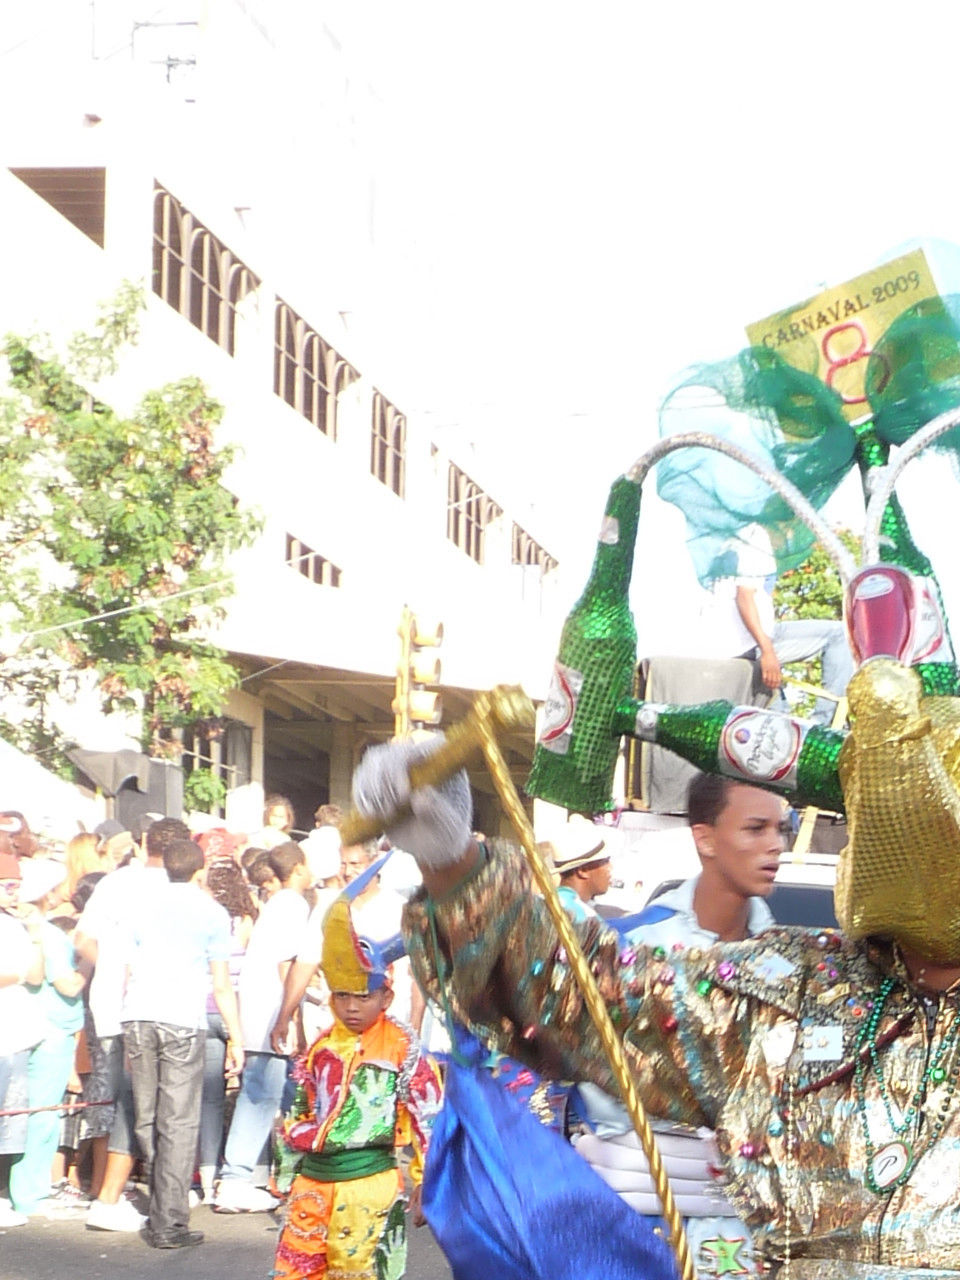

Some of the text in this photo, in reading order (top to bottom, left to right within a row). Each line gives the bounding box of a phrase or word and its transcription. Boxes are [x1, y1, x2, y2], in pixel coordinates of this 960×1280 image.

[762, 270, 920, 350] CARNAVAL 2009
[878, 1155, 898, 1176] P
